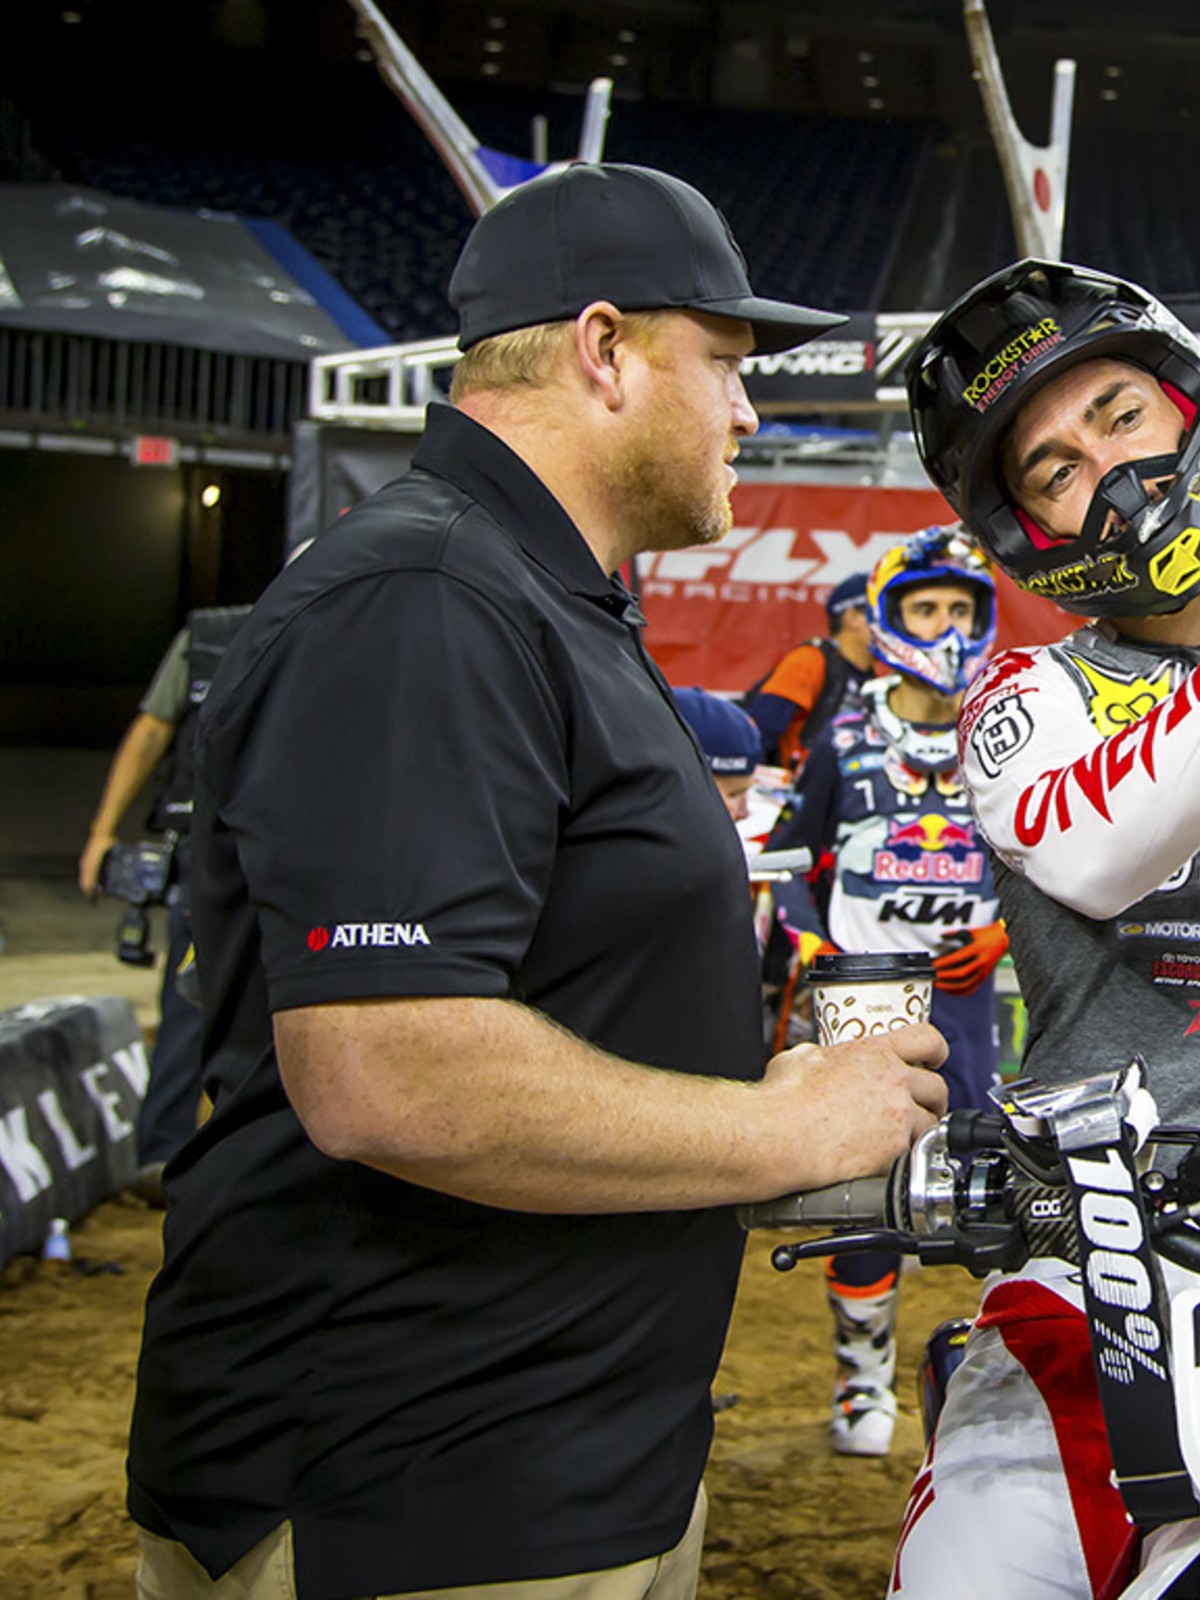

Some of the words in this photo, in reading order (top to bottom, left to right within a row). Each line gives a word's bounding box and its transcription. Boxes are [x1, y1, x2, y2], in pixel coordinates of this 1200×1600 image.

[873, 852, 930, 881] Red
[933, 851, 983, 882] Bull
[877, 893, 974, 926] KTM
[331, 923, 431, 948] ATHENA
